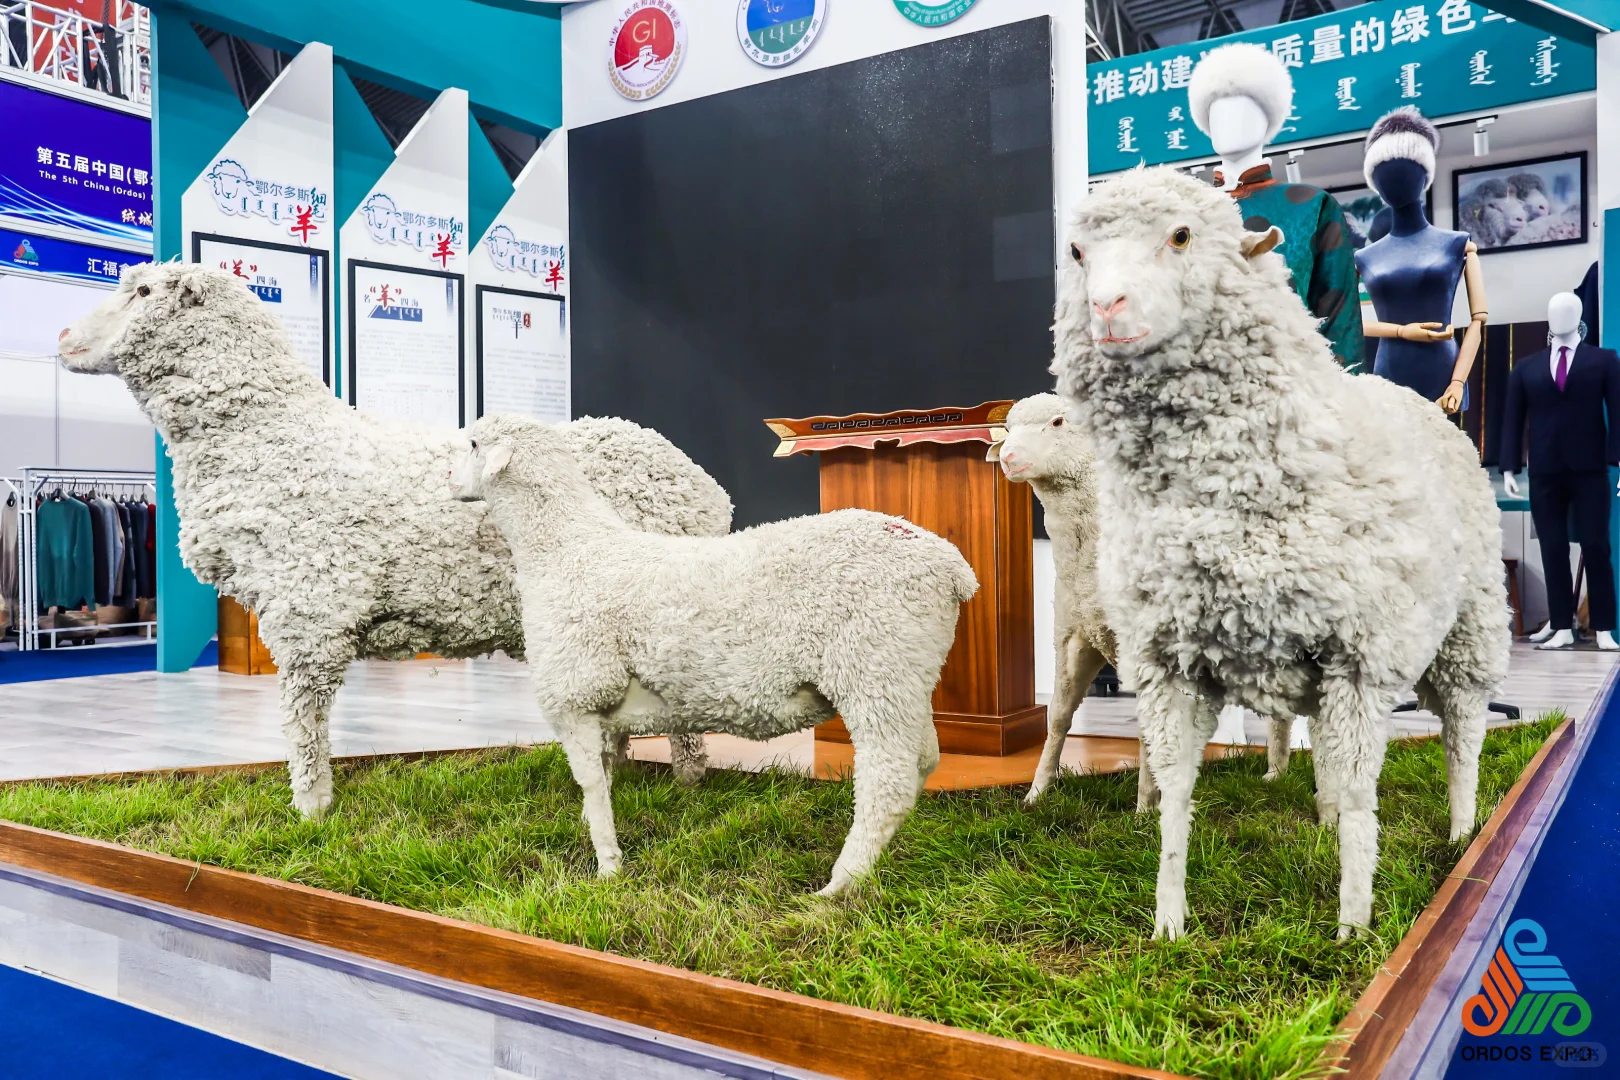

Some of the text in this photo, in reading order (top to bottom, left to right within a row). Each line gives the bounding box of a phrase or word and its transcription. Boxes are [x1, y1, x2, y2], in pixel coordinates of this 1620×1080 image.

[632, 18, 657, 43] GI
[1087, 0, 1517, 105] 推动建质量的绿色
[37, 146, 153, 186] 第五届中国(鄂
[39, 170, 57, 181] The
[62, 175, 78, 185] 5th
[83, 180, 110, 192] China
[112, 185, 146, 200] (Ordos)
